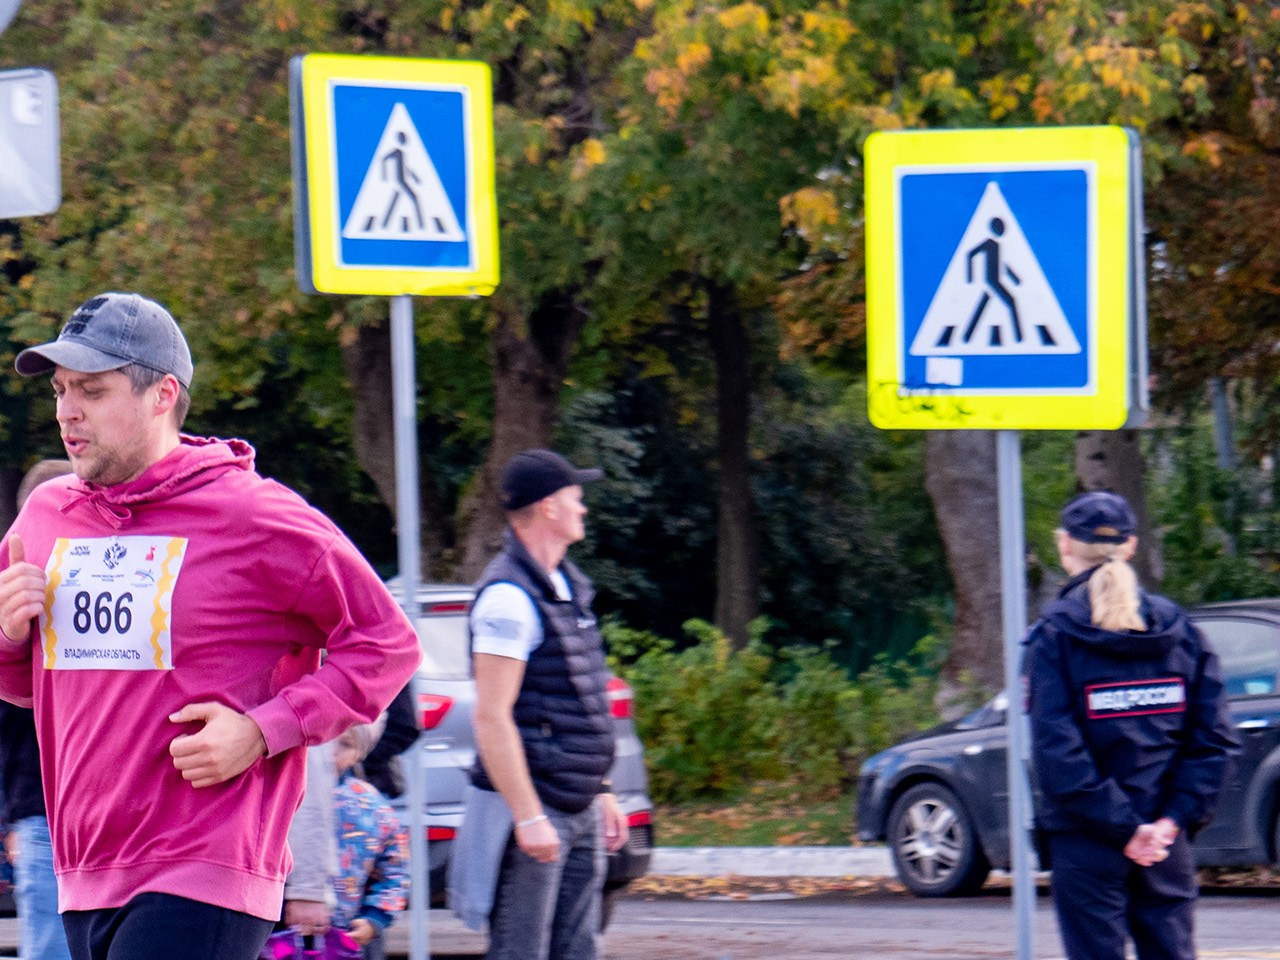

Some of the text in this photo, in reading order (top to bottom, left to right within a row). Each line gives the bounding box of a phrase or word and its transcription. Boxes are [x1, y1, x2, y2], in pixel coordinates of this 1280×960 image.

[73, 590, 134, 635] 866
[64, 647, 141, 660] ВЛАДИМИРСКАЯ ОБЛАСТЬ
